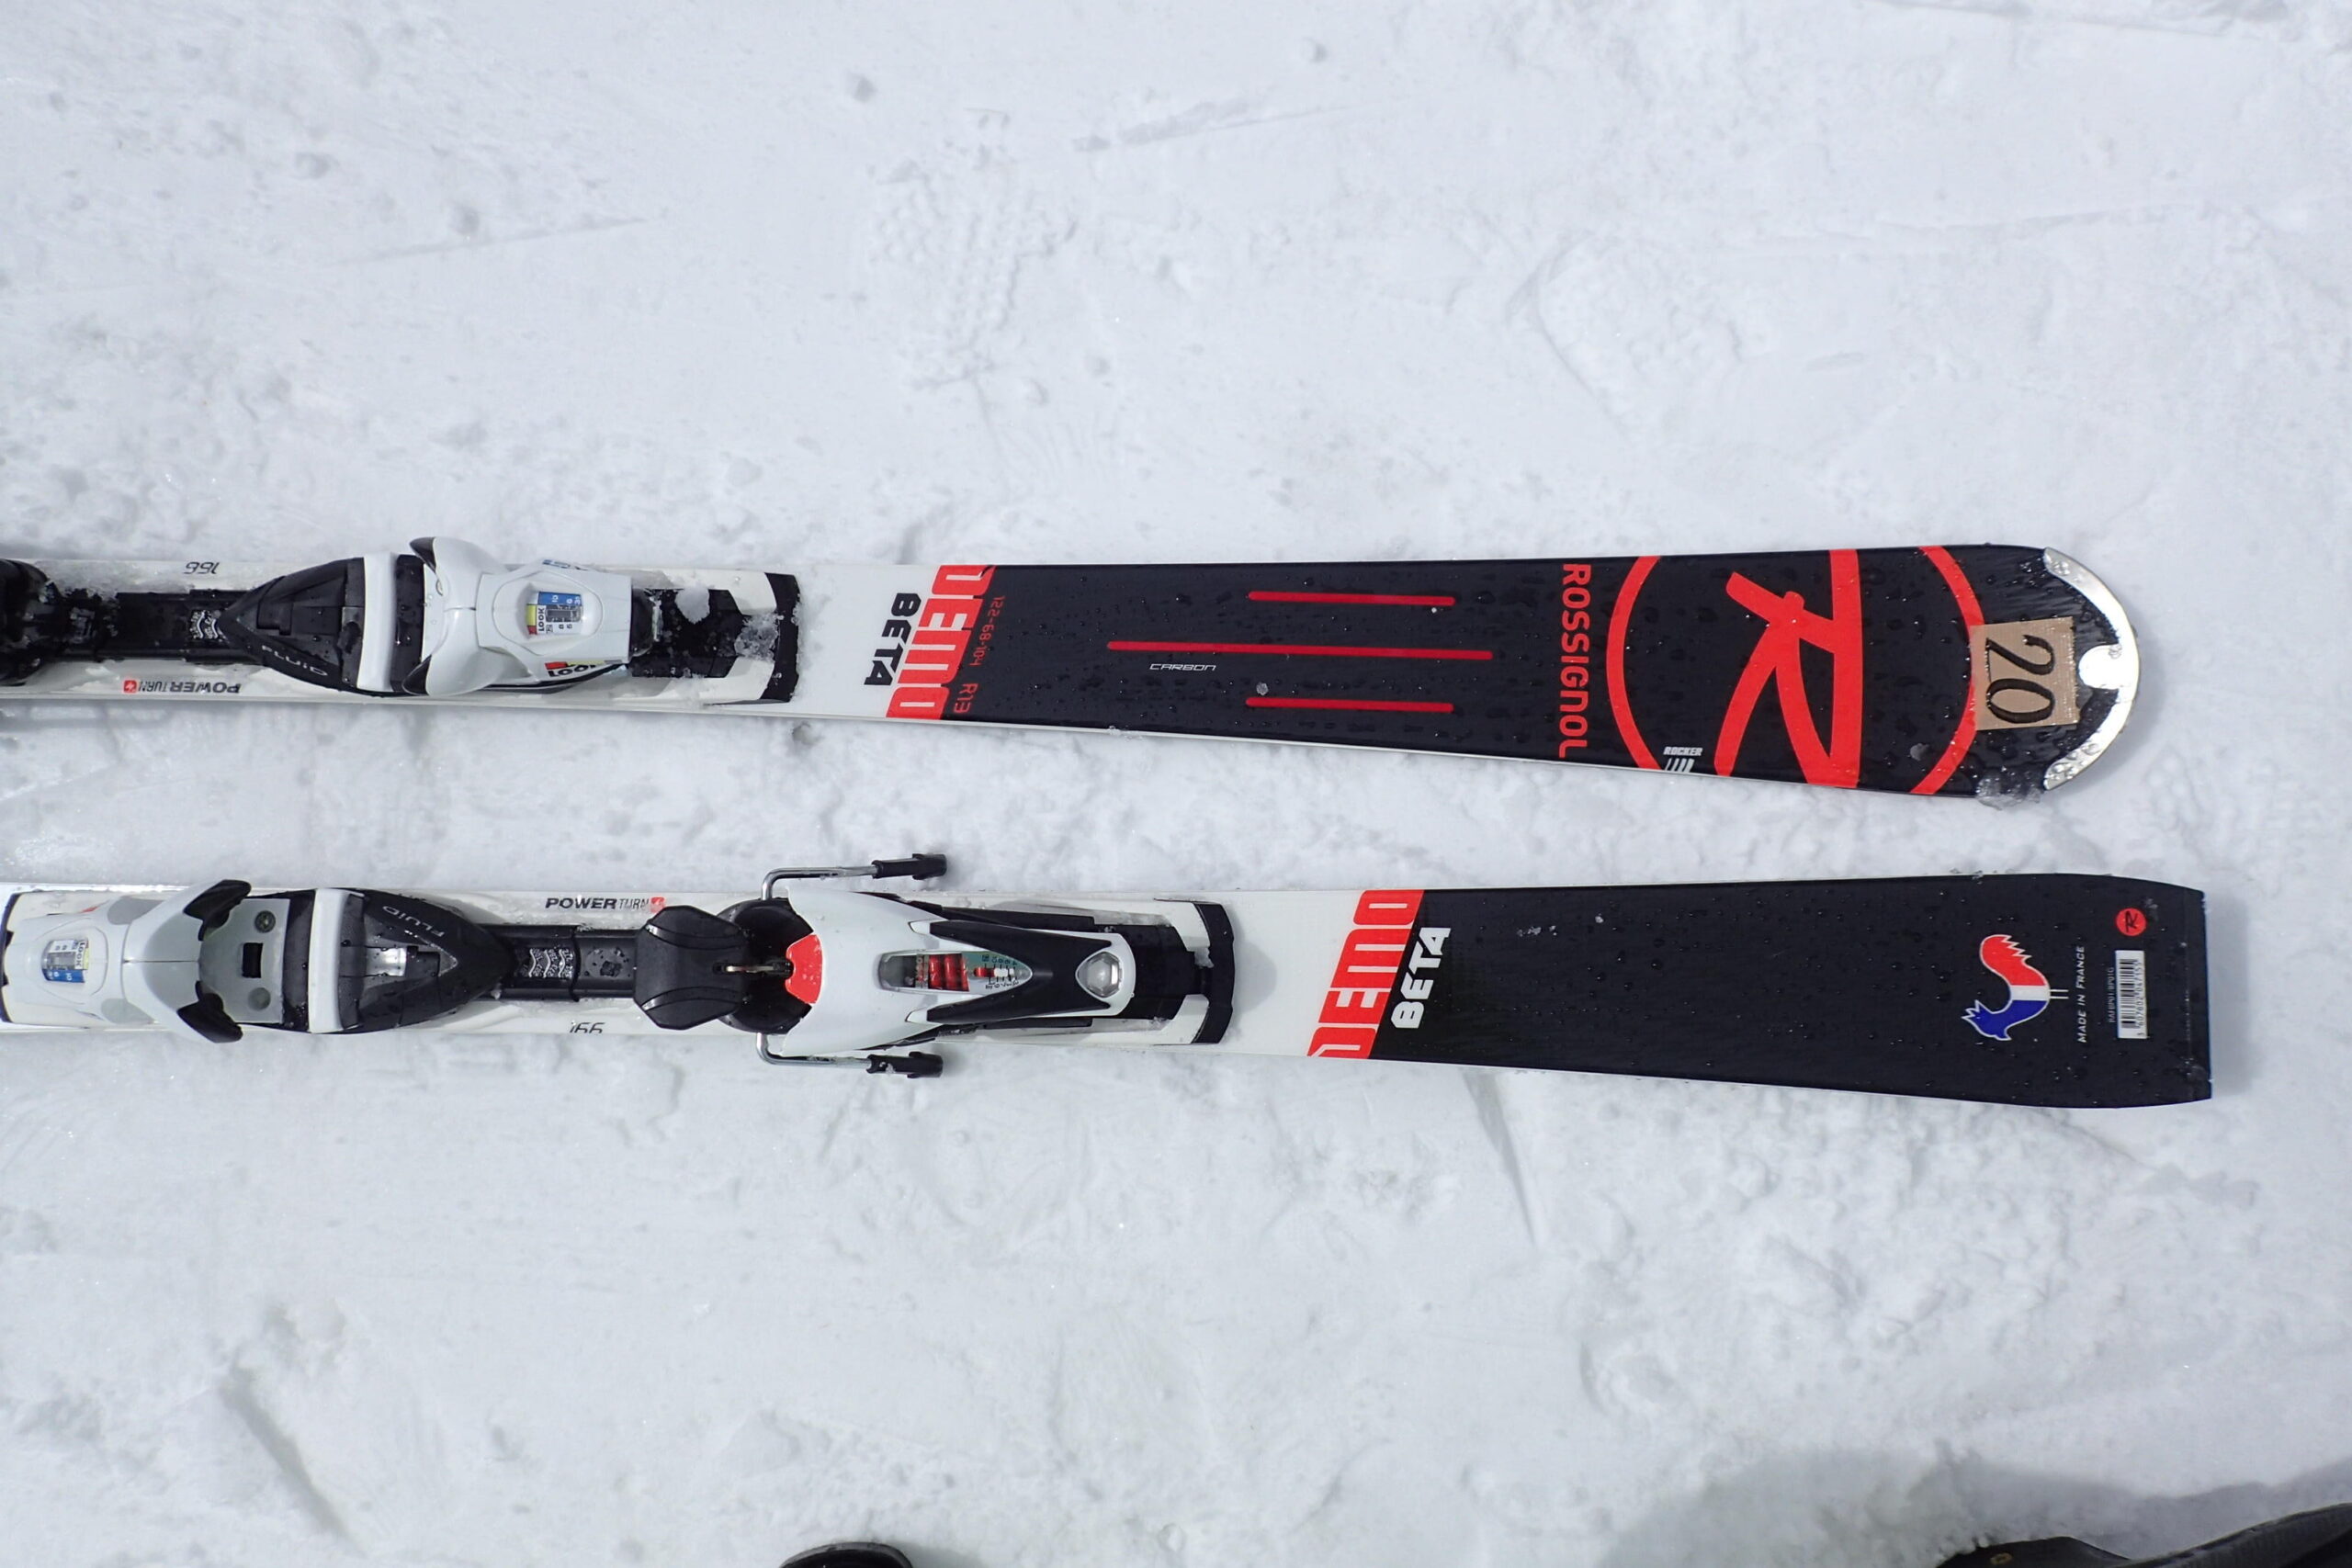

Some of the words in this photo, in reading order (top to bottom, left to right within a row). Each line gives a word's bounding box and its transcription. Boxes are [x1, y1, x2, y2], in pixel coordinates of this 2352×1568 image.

[184, 561, 220, 575] 166
[537, 607, 546, 632] LOOK
[864, 592, 922, 686] BETA
[886, 564, 999, 721] DEMO
[548, 663, 596, 677] LOO
[1148, 662, 1217, 672] CARBON
[1558, 563, 1592, 759] ROSSIGNOL
[1984, 634, 2056, 724] 20
[953, 682, 979, 715] R13
[1663, 745, 1703, 757] ROCKER
[1306, 889, 1425, 1060] DEMO
[1390, 926, 1452, 1030] BETA
[2075, 945, 2086, 990] FRANCE
[2077, 994, 2086, 1008] IN
[2076, 1010, 2087, 1043] MADE
